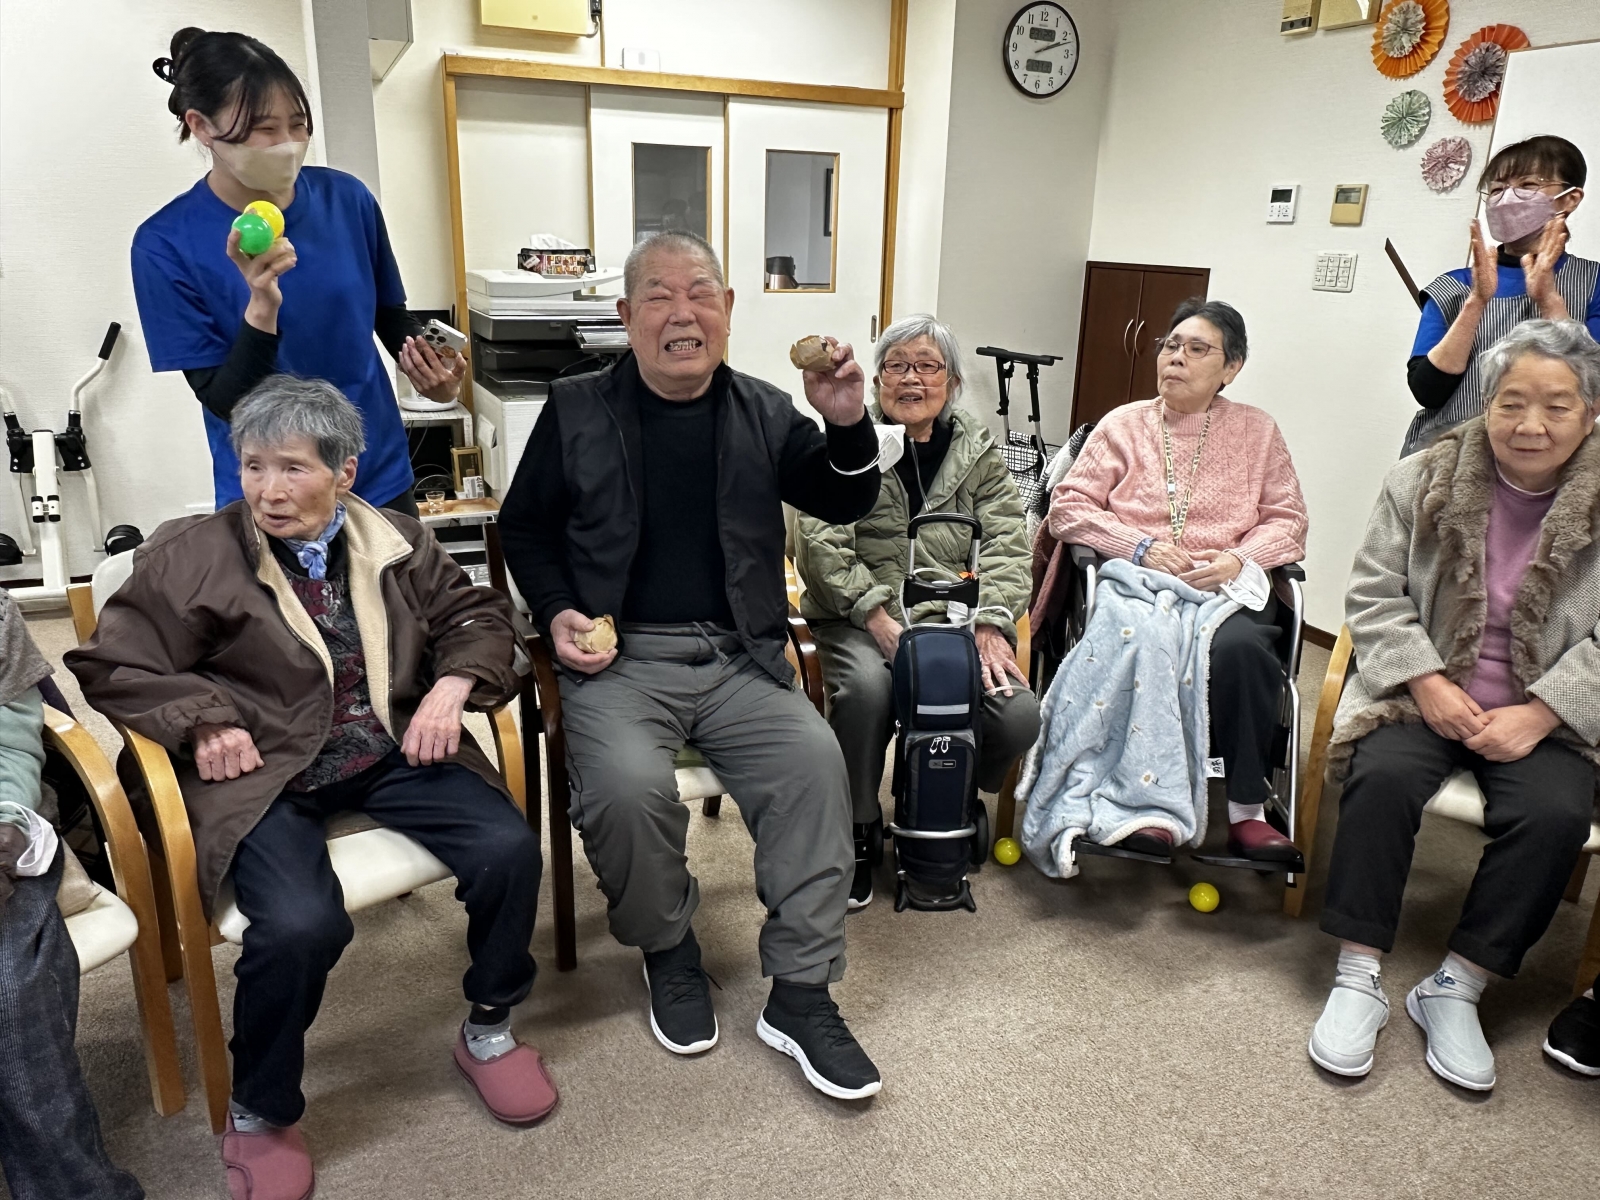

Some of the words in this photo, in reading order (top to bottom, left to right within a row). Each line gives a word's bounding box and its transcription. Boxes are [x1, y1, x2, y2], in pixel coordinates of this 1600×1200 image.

[1027, 13, 1034, 25] 11
[1040, 10, 1049, 22] 12
[1016, 25, 1025, 36] 10
[1062, 31, 1068, 41] 2
[1012, 42, 1018, 52] 9
[1063, 49, 1069, 59] 3
[1013, 60, 1020, 69] 8
[1058, 65, 1063, 76] 4
[1023, 73, 1028, 84] 7
[1048, 77, 1054, 87] 5
[1034, 79, 1040, 89] 6
